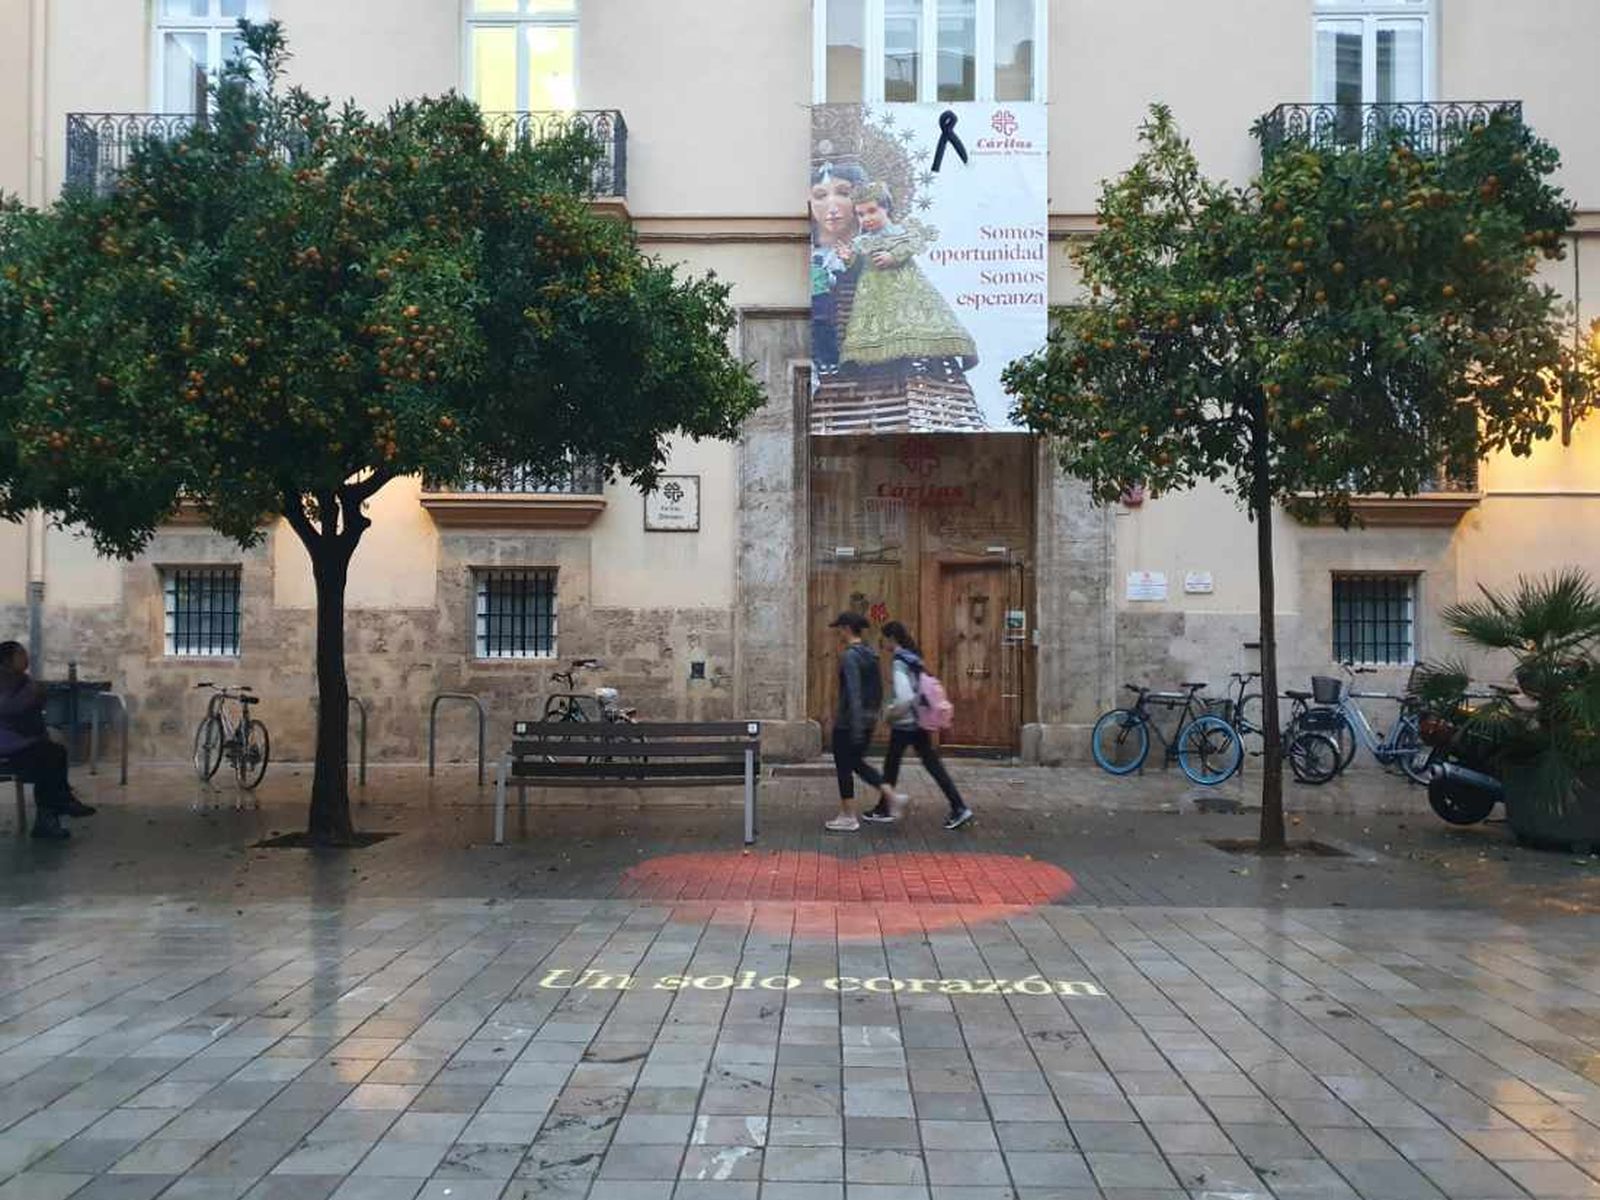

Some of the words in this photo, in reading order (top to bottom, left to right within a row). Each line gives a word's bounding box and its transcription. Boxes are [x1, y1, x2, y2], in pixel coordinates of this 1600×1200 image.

[980, 226, 1044, 240] Somos
[930, 243, 1044, 266] oportunidad
[980, 271, 1045, 285] Somos
[956, 292, 1044, 310] esperanza
[539, 969, 638, 990] Un
[653, 970, 802, 990] solo
[823, 975, 1107, 996] corazón
